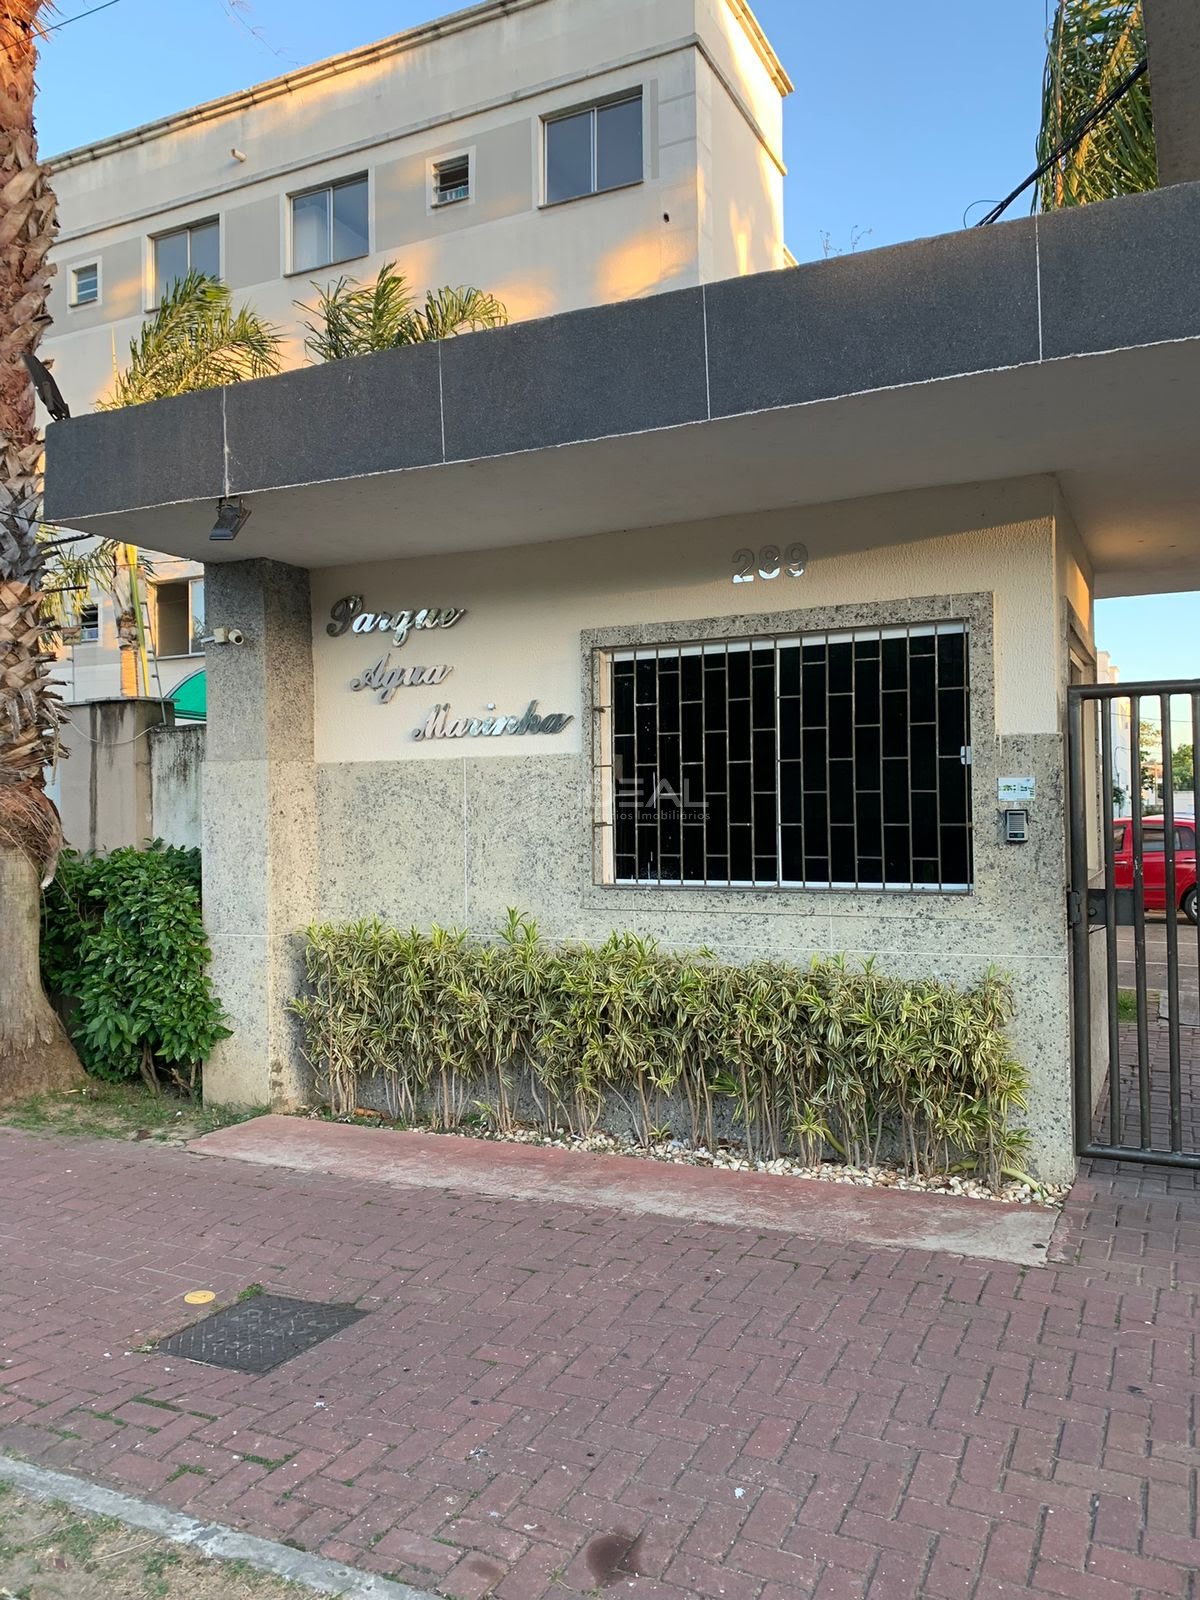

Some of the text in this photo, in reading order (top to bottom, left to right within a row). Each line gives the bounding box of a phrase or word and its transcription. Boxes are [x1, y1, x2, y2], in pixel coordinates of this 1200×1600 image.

[731, 542, 808, 584] 289
[326, 594, 468, 647] Parque
[350, 652, 454, 704] Agua
[411, 699, 574, 742] Marinha
